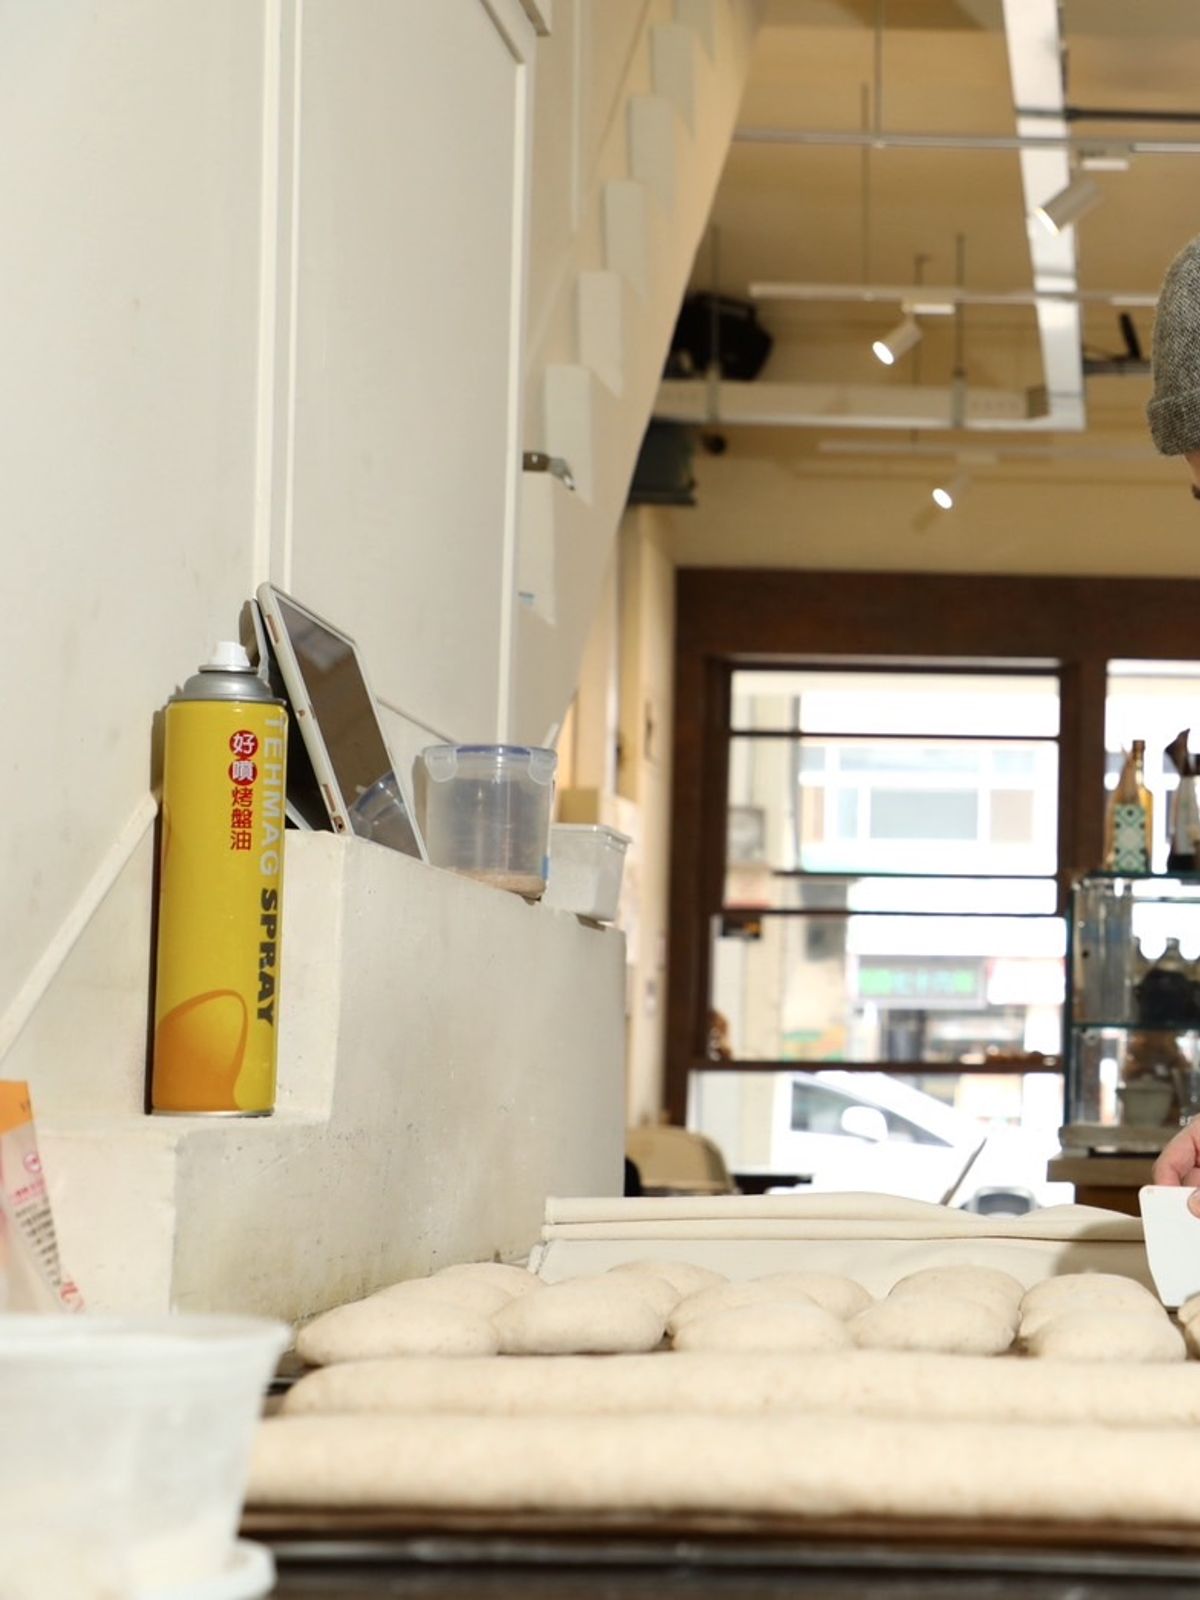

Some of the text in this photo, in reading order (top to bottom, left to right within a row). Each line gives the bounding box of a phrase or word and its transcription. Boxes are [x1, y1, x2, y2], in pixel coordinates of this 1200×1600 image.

[230, 732, 256, 851] 好噴烤盤油
[257, 718, 285, 1026] TEHMAG SPRAY
